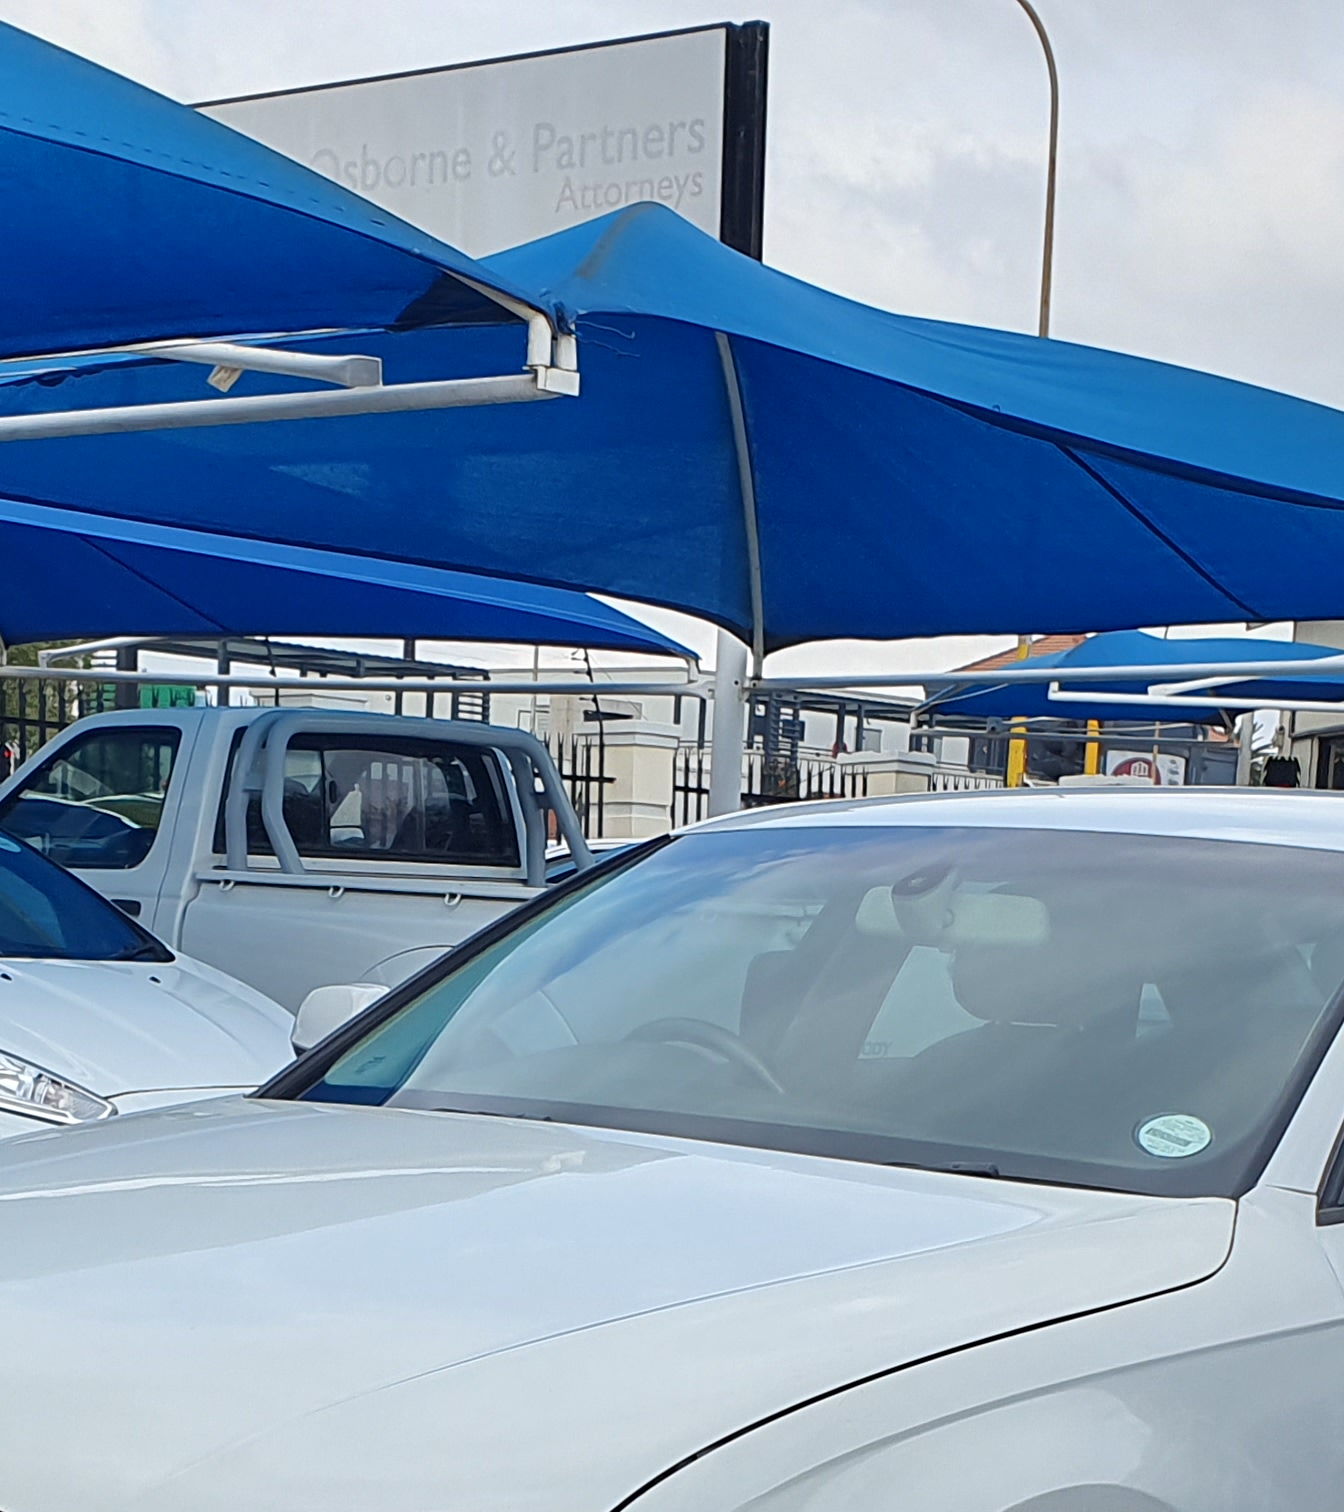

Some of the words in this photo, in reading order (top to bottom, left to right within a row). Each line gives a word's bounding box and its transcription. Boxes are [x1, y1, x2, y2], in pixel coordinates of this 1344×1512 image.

[486, 130, 517, 178] &
[532, 118, 706, 174] Partners
[555, 171, 704, 214] Attorneys
